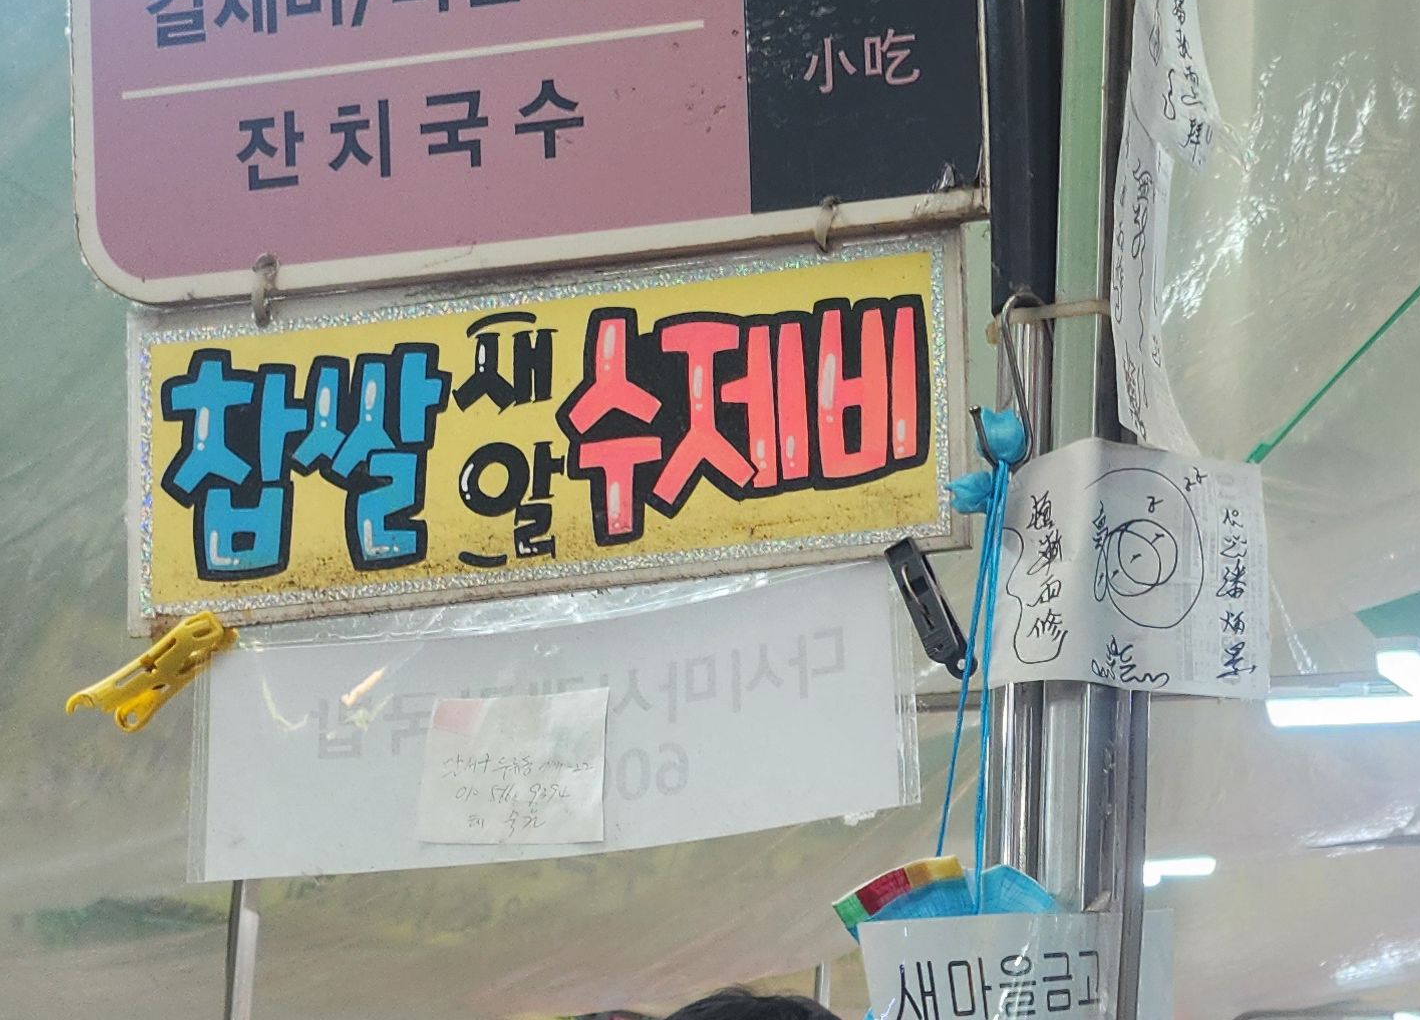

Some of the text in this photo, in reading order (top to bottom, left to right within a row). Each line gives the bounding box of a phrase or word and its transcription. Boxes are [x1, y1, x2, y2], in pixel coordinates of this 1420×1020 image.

[803, 30, 921, 95] 小吃
[235, 78, 586, 193] 잔치국수
[161, 346, 451, 580] 찹쌀
[556, 293, 932, 547] 수제비
